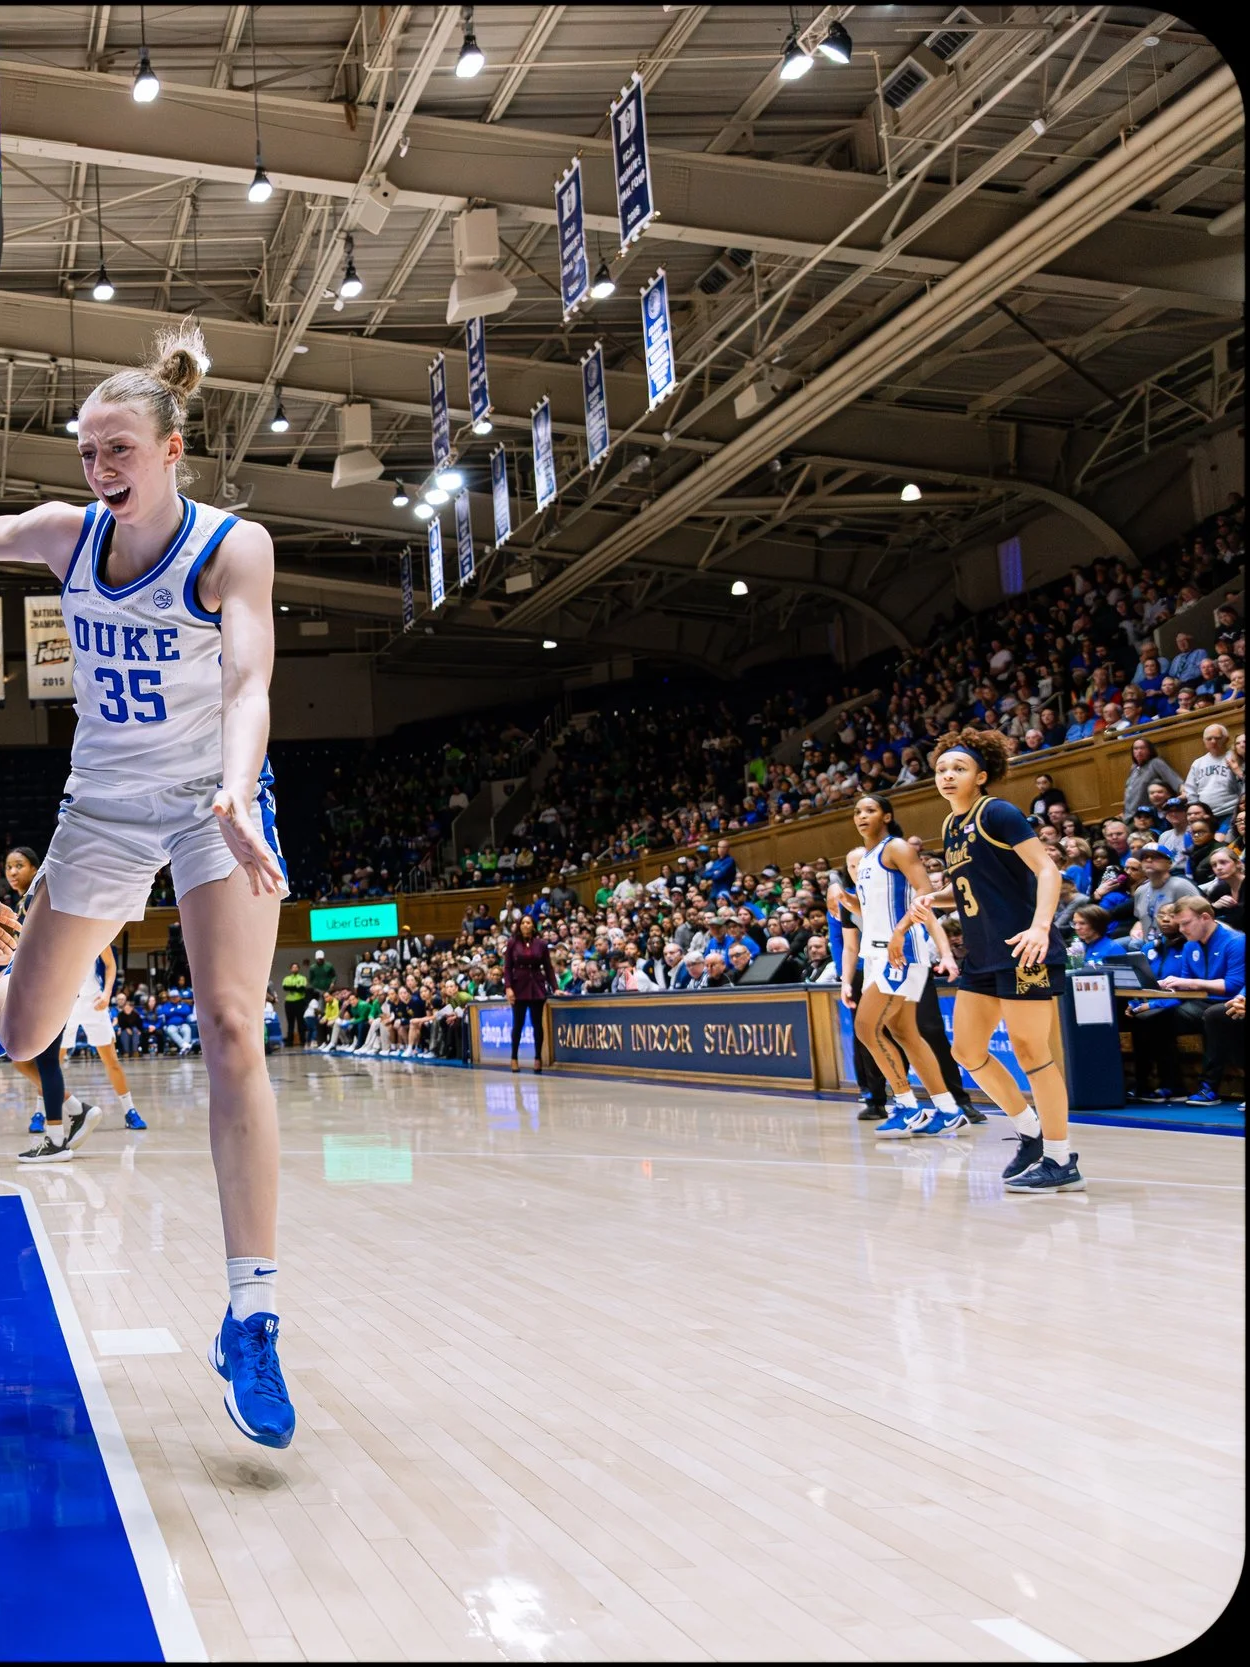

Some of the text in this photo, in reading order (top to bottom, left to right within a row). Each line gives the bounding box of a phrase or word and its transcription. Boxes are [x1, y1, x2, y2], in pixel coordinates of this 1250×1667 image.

[33, 609, 63, 617] NATIONA
[74, 615, 180, 661] DUKE
[42, 677, 65, 686] 2015
[94, 667, 167, 723] 35
[956, 876, 979, 917] 3
[326, 916, 380, 930] Uber Eats
[557, 1023, 797, 1058] CAMERON INDOOR STADIUM
